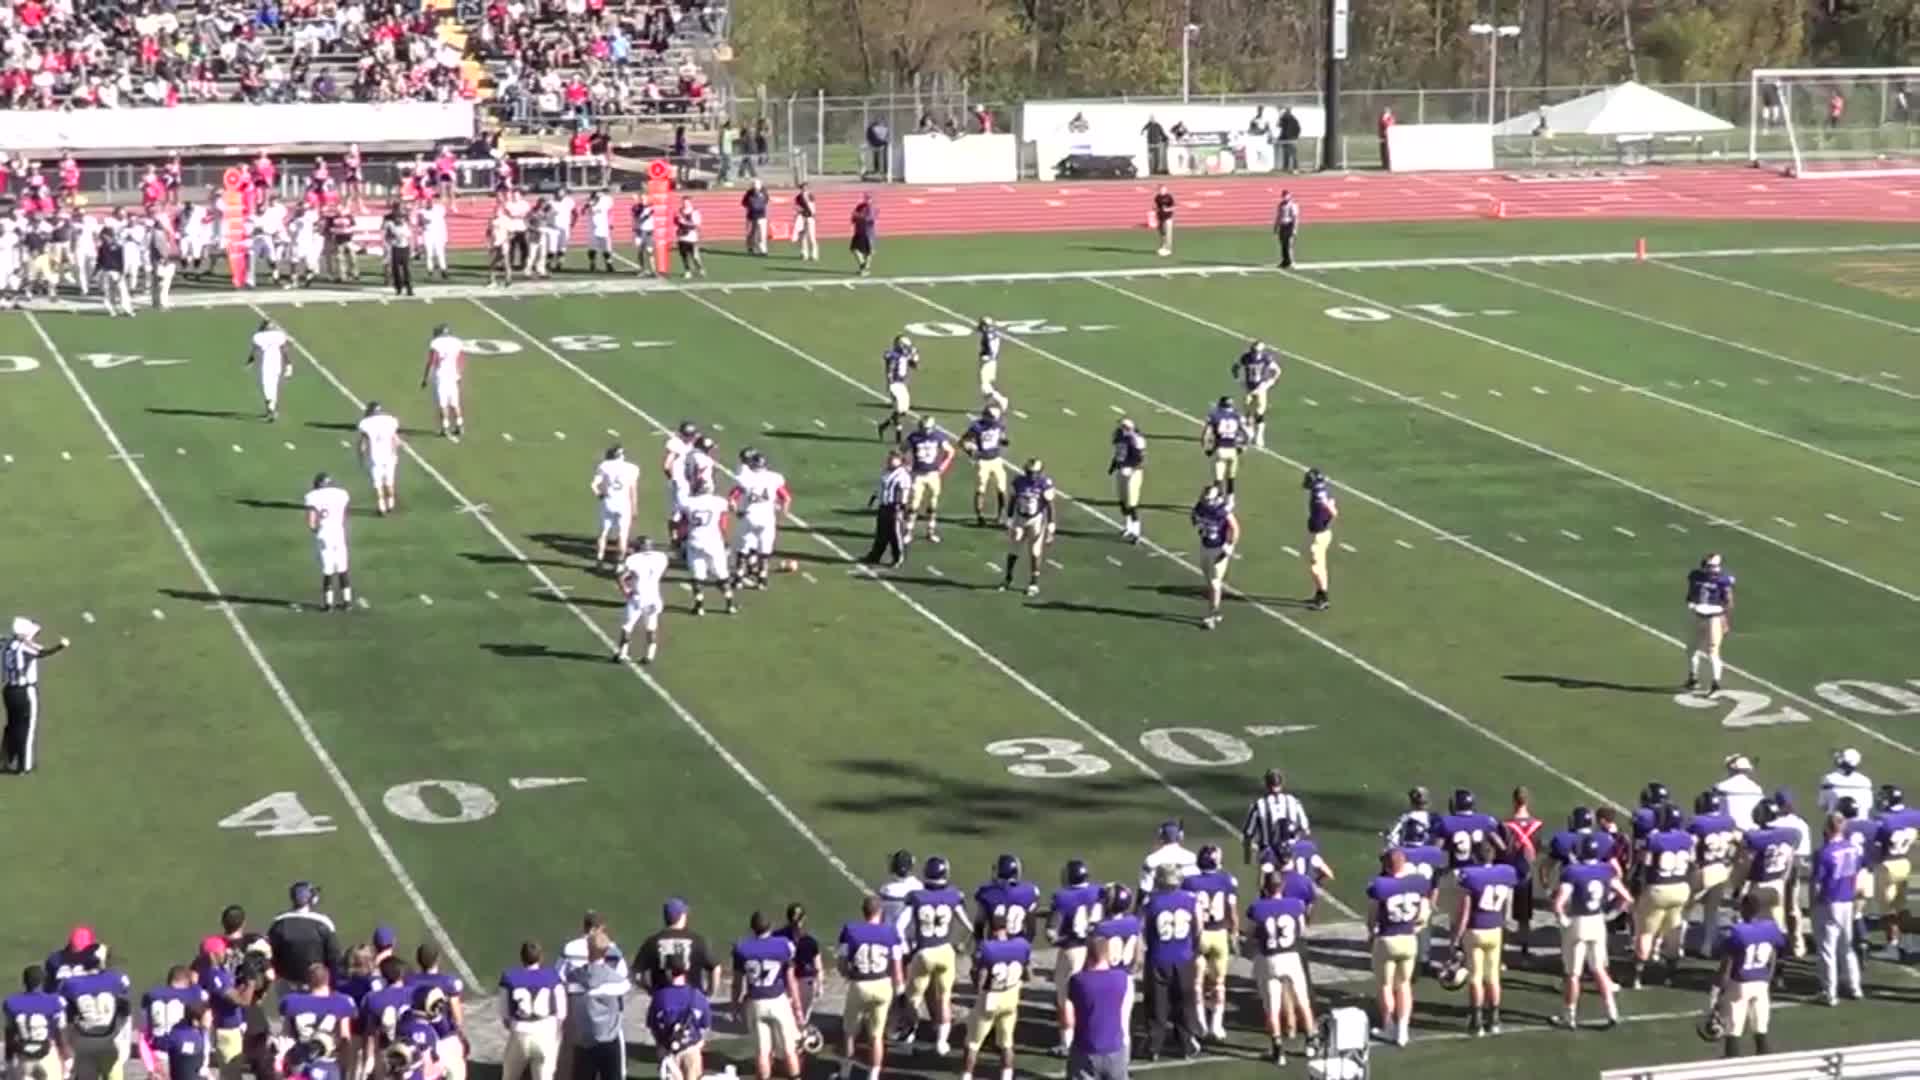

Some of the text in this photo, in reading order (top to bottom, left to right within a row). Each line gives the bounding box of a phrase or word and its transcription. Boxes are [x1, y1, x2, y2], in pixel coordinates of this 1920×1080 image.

[1323, 303, 1476, 321] 10
[691, 510, 713, 527] 57
[1672, 679, 1920, 727] 20
[984, 727, 1253, 778] 30
[218, 779, 499, 837] 40
[1387, 892, 1421, 922] 55
[1479, 884, 1509, 912] 47
[1586, 879, 1604, 911] 3
[1265, 913, 1296, 949] 13
[854, 942, 889, 975] 45
[512, 986, 551, 1017] 34
